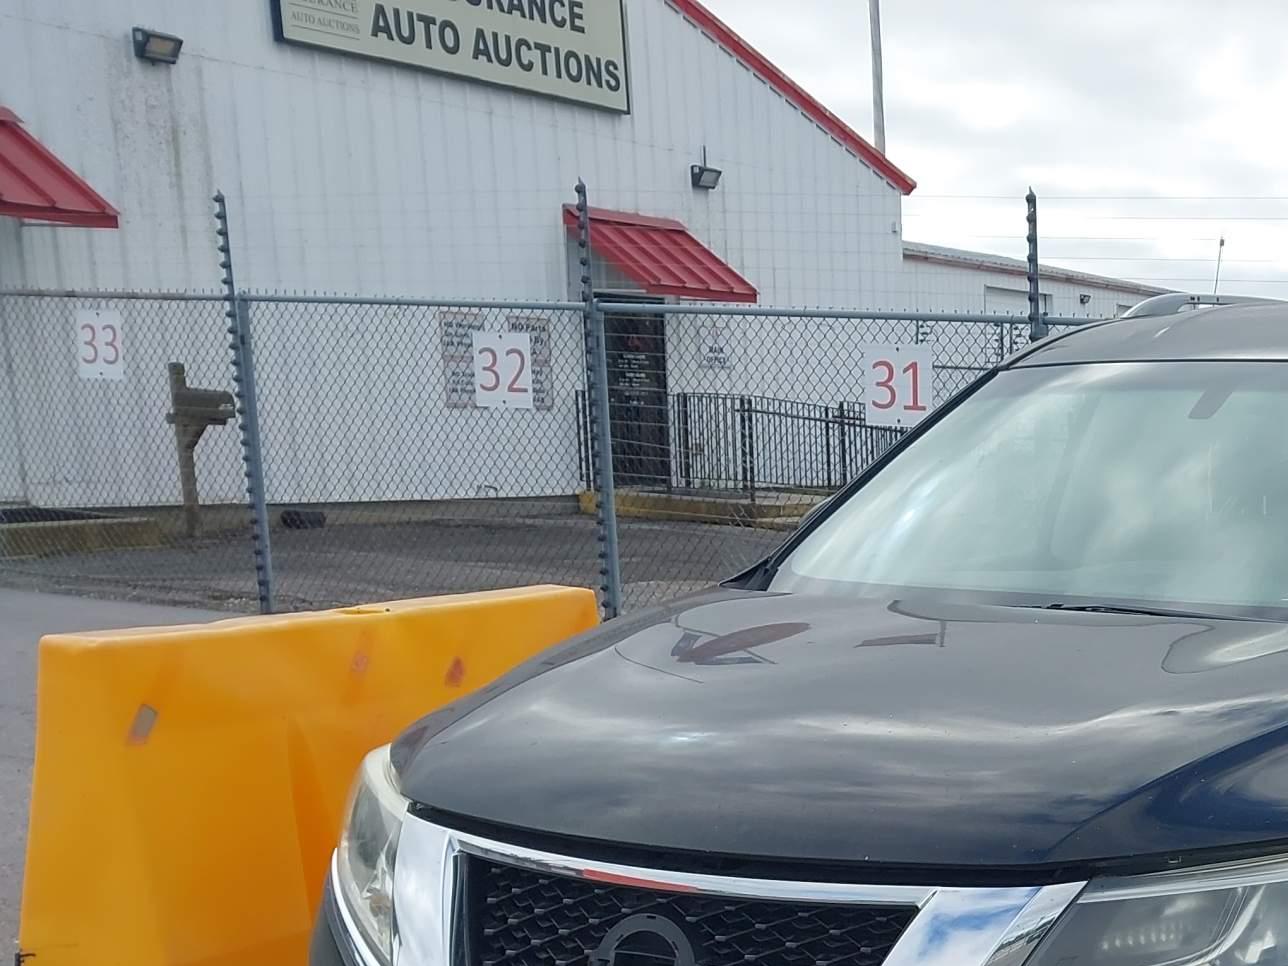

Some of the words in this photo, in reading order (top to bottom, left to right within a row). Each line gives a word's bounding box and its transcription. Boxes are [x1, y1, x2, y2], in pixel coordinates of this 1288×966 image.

[291, 11, 315, 24] AUTO
[317, 16, 360, 34] AUCTIONS
[371, 3, 460, 55] AUTO
[472, 27, 621, 92] AUCTIONS
[80, 323, 120, 365] 33
[478, 347, 529, 393] 32
[870, 359, 928, 412] 31
